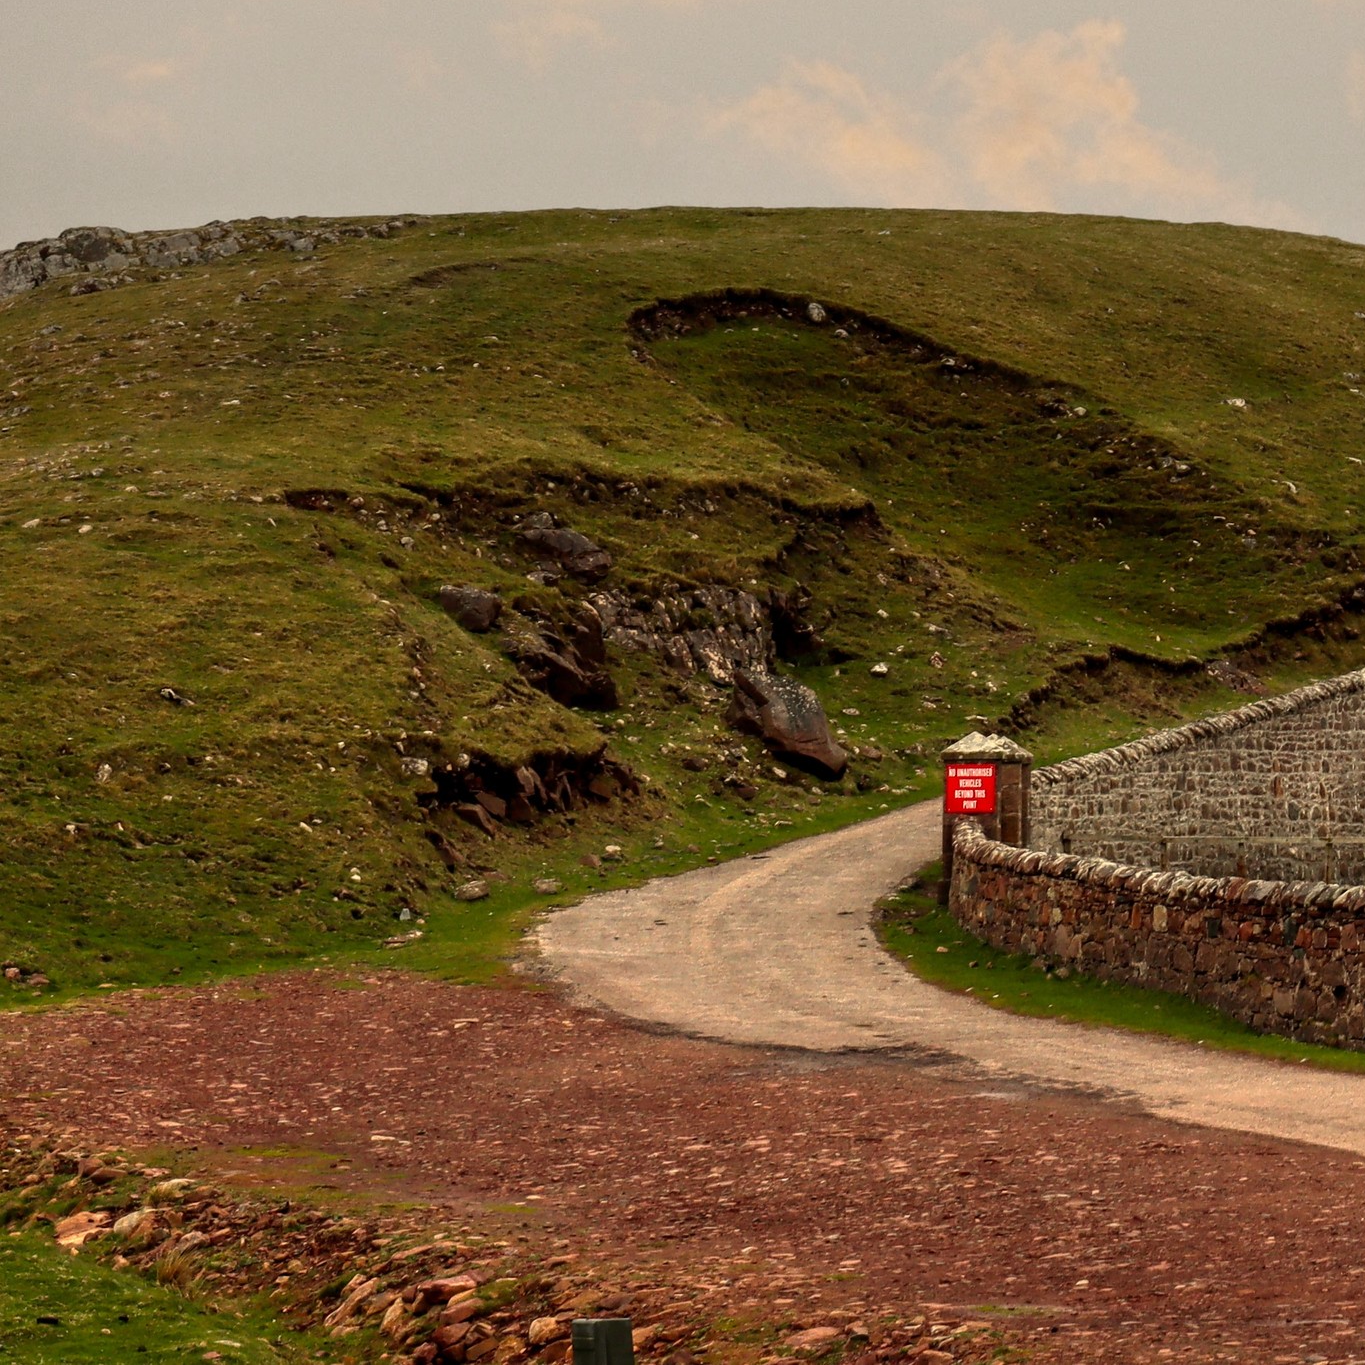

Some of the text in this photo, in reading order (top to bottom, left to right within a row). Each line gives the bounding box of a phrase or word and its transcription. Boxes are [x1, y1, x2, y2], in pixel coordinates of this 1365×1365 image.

[949, 768, 992, 776] NO UNAUTHORISED
[959, 779, 982, 787] VEHICLES
[955, 789, 986, 798] BEYOND THIS
[963, 800, 977, 809] POINT
